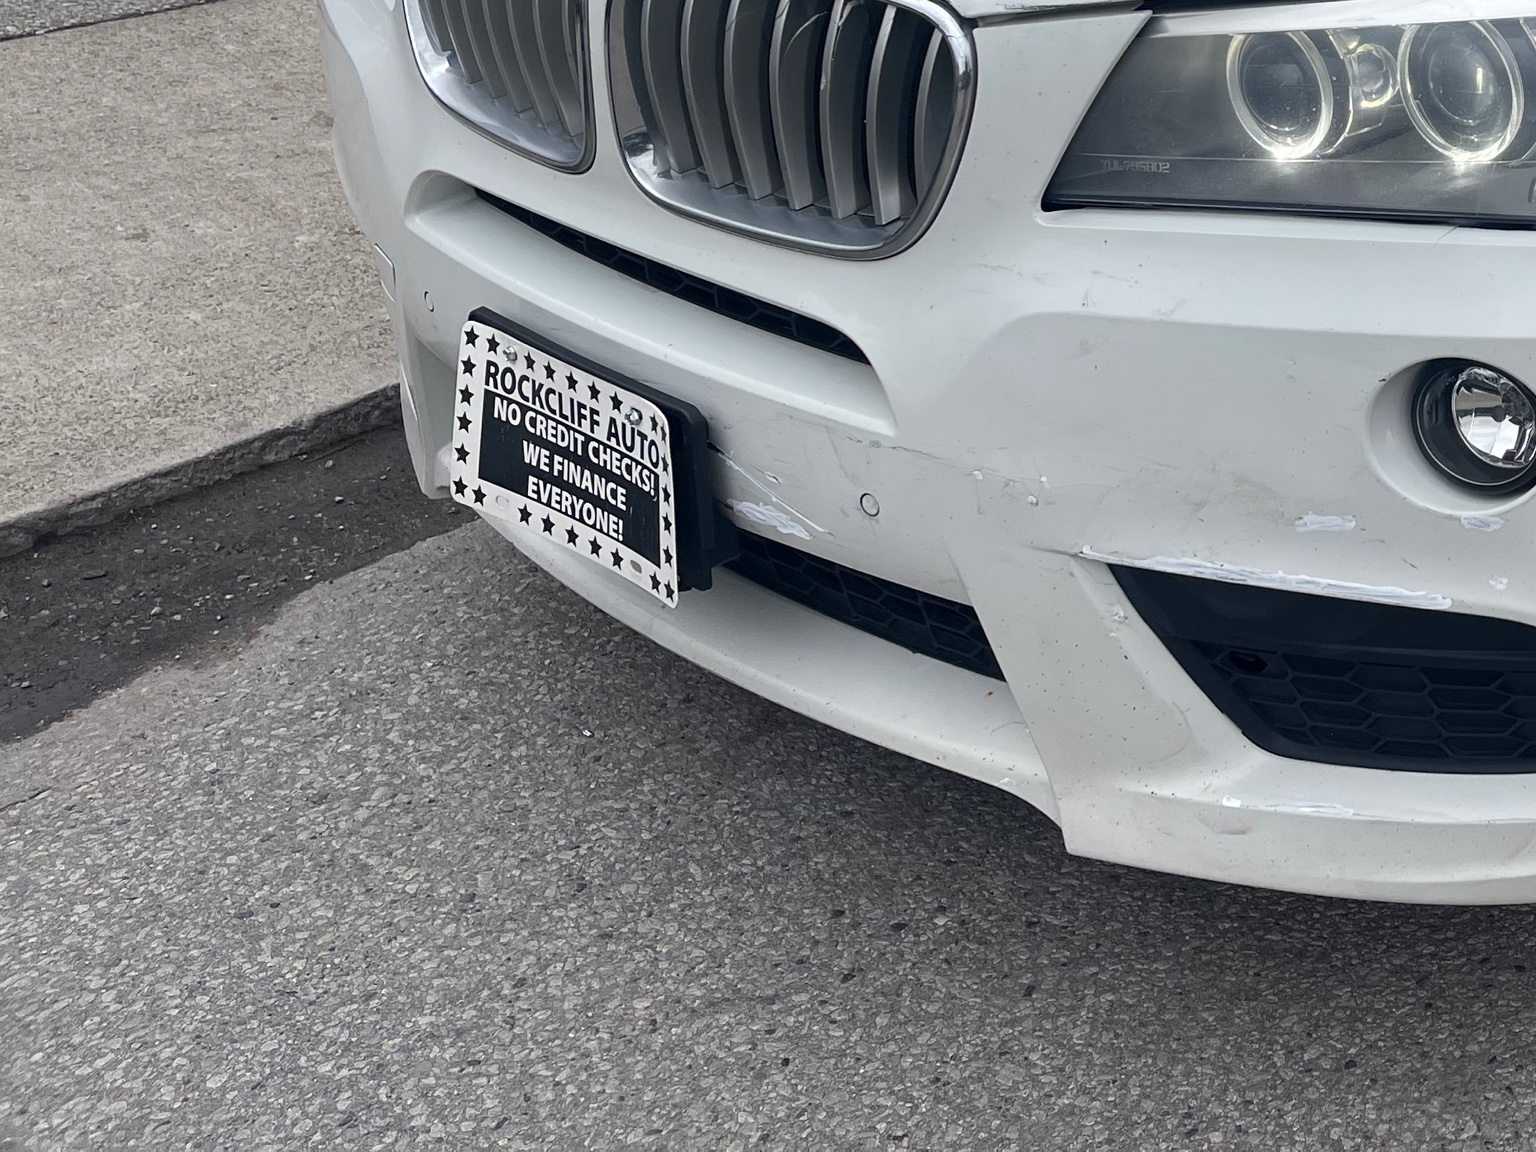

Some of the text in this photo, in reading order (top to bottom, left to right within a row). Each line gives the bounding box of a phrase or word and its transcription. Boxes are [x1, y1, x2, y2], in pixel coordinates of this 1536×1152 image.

[484, 359, 660, 470] ROCKCLIFF AUTO
[493, 396, 656, 496] NO CREDIT CHECKS!
[522, 440, 627, 511] WE FINANCE
[527, 475, 624, 542] EVERYONE!
